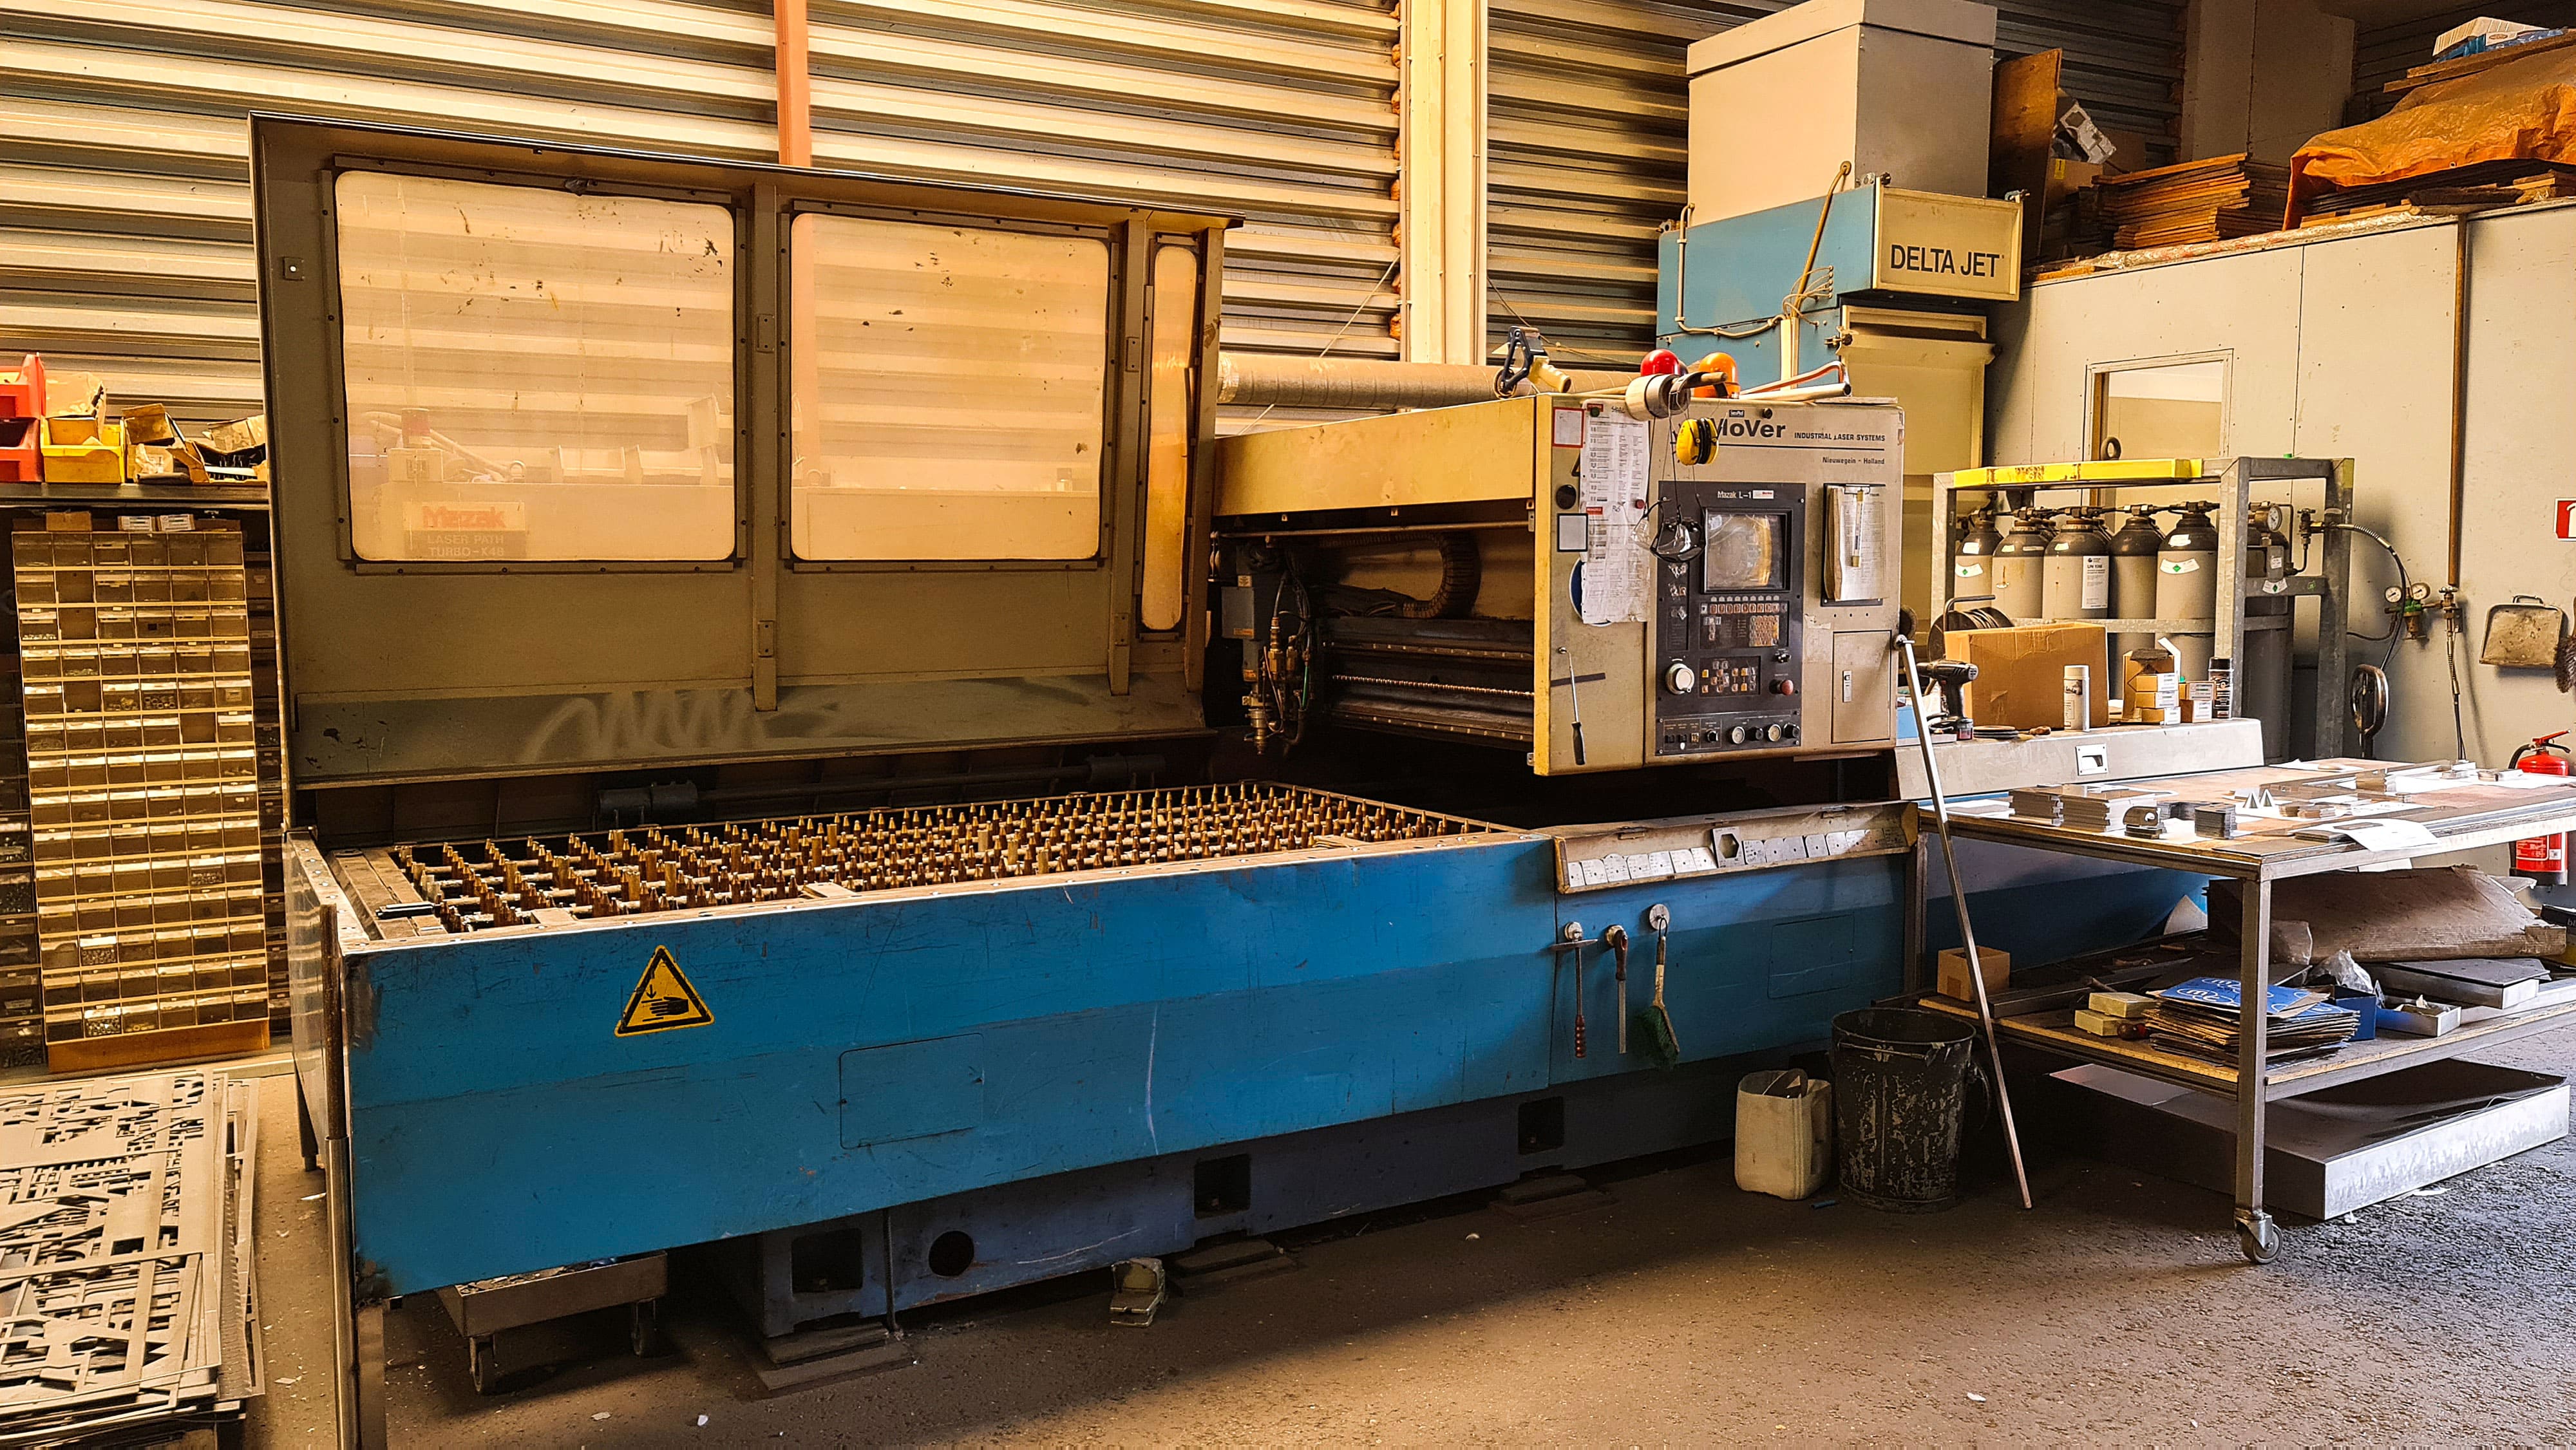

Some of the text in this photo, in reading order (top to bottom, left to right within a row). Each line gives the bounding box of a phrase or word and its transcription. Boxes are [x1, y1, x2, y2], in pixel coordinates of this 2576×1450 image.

[1891, 244, 2000, 278] DELTA JET
[1710, 418, 1786, 438] MoVer
[1857, 433, 1885, 442] SYSTEMS
[427, 534, 504, 545] LASER PATH
